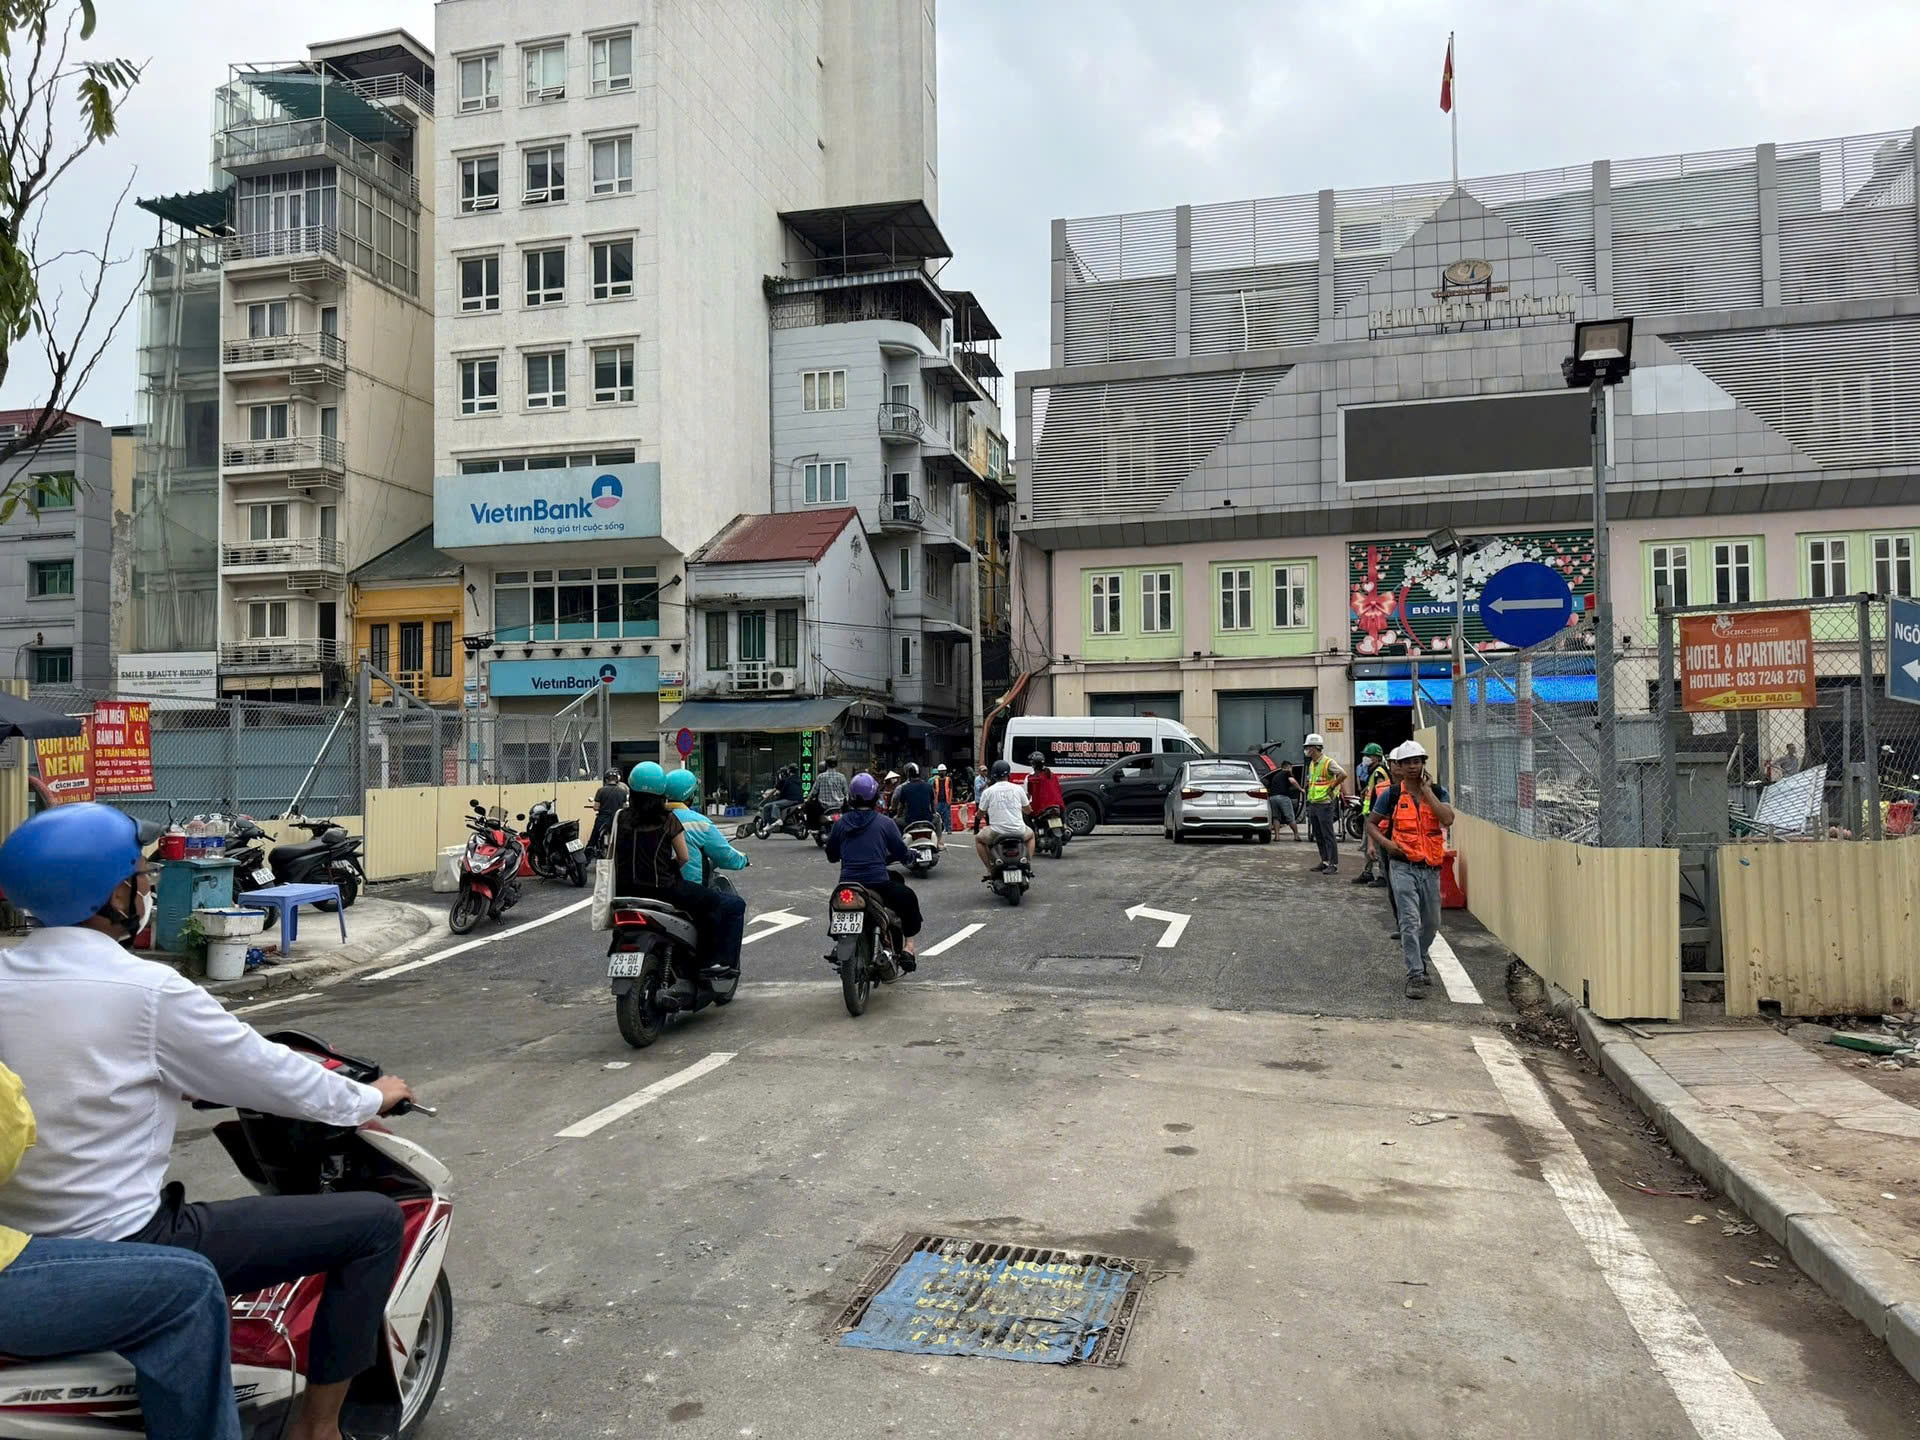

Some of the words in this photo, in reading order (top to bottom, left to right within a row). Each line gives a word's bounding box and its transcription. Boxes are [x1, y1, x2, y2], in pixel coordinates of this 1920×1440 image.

[470, 497, 593, 524] VietinBank
[1412, 604, 1450, 615] BỆNH
[1686, 644, 1721, 671] HOTEL
[1724, 643, 1733, 669] &
[1736, 639, 1807, 668] APARTMENT
[121, 671, 144, 679] SMILE
[147, 670, 177, 679] BEAUTY
[180, 668, 213, 677] BUILDING
[1690, 672, 1735, 689] HOTLINE:
[1737, 671, 1756, 687] 033
[1759, 670, 1784, 686] 7248
[1786, 669, 1806, 684] 276
[531, 676, 600, 690] VietinBank
[1723, 696, 1737, 704] 33
[129, 706, 149, 722] NGAN
[96, 728, 113, 745] BÁNH
[1051, 740, 1074, 753] BỆNH
[1075, 740, 1094, 753] VIỆN
[1095, 742, 1111, 752] TIM
[1112, 740, 1124, 752] HÀ
[1125, 740, 1140, 754] NỘI
[45, 755, 85, 777] NEM
[610, 965, 639, 976] 144.95
[4, 1389, 63, 1402] AIR
